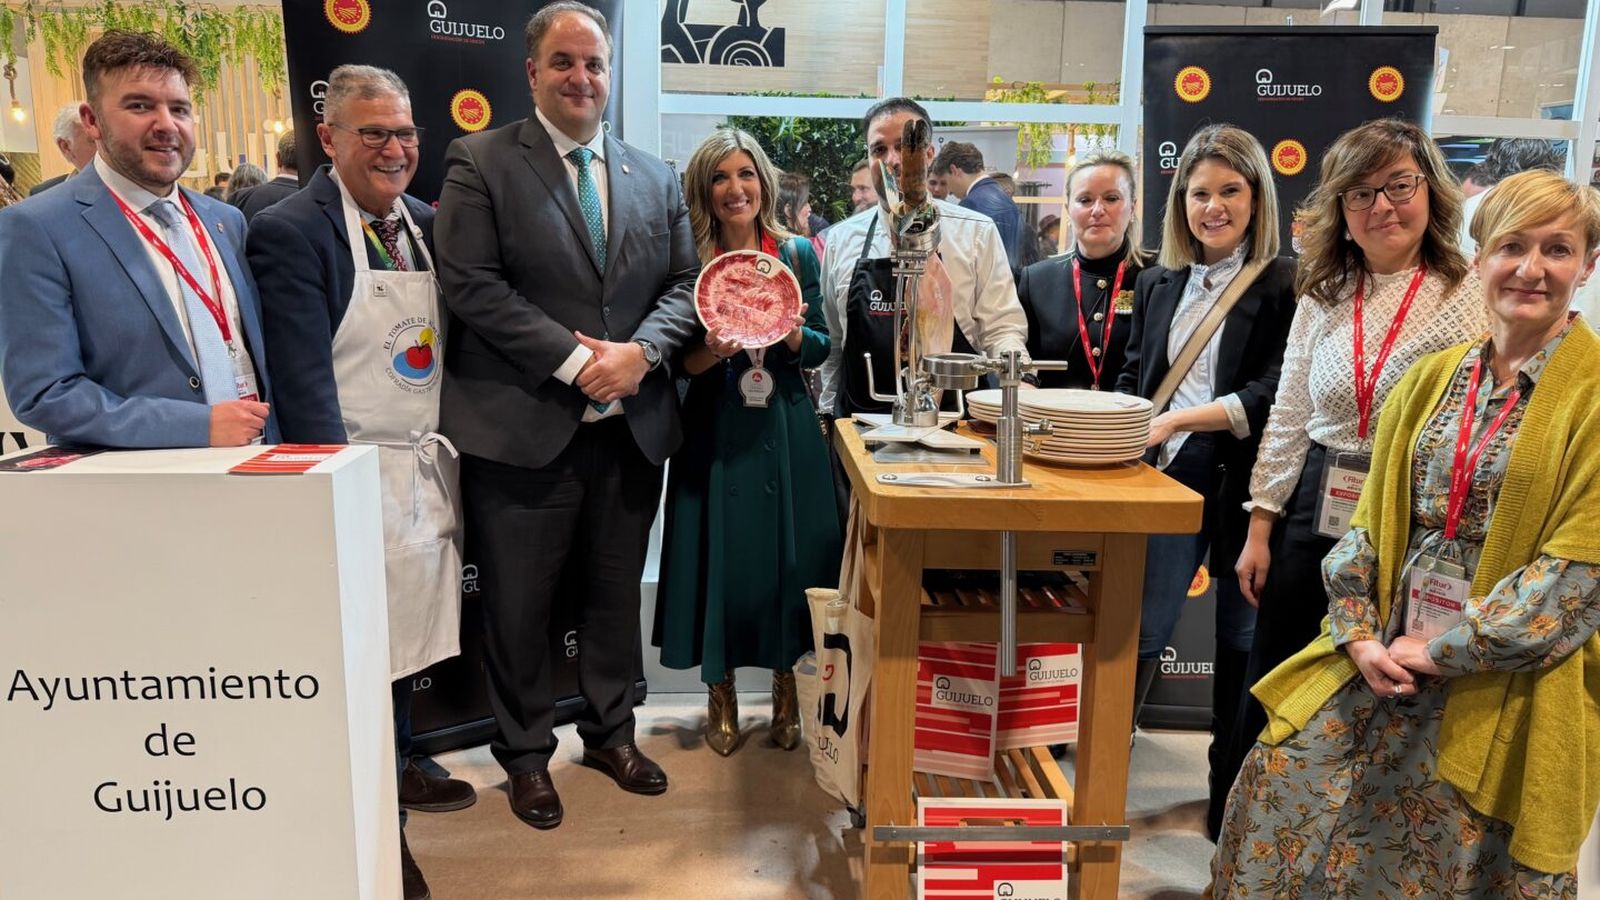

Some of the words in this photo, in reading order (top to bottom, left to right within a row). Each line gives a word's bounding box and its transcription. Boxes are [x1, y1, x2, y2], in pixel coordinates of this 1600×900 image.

[429, 19, 505, 40] GUIJUELO
[1257, 84, 1322, 96] GUIJUELO
[388, 317, 416, 338] TOMATE
[417, 316, 427, 324] DE
[1030, 668, 1078, 681] GUIJUELO
[1161, 662, 1215, 674] GUIJUEL
[7, 667, 319, 711] Ayuntamiento
[936, 690, 993, 707] GUIJUELO
[144, 723, 196, 756] de
[94, 778, 267, 821] Guijuelo
